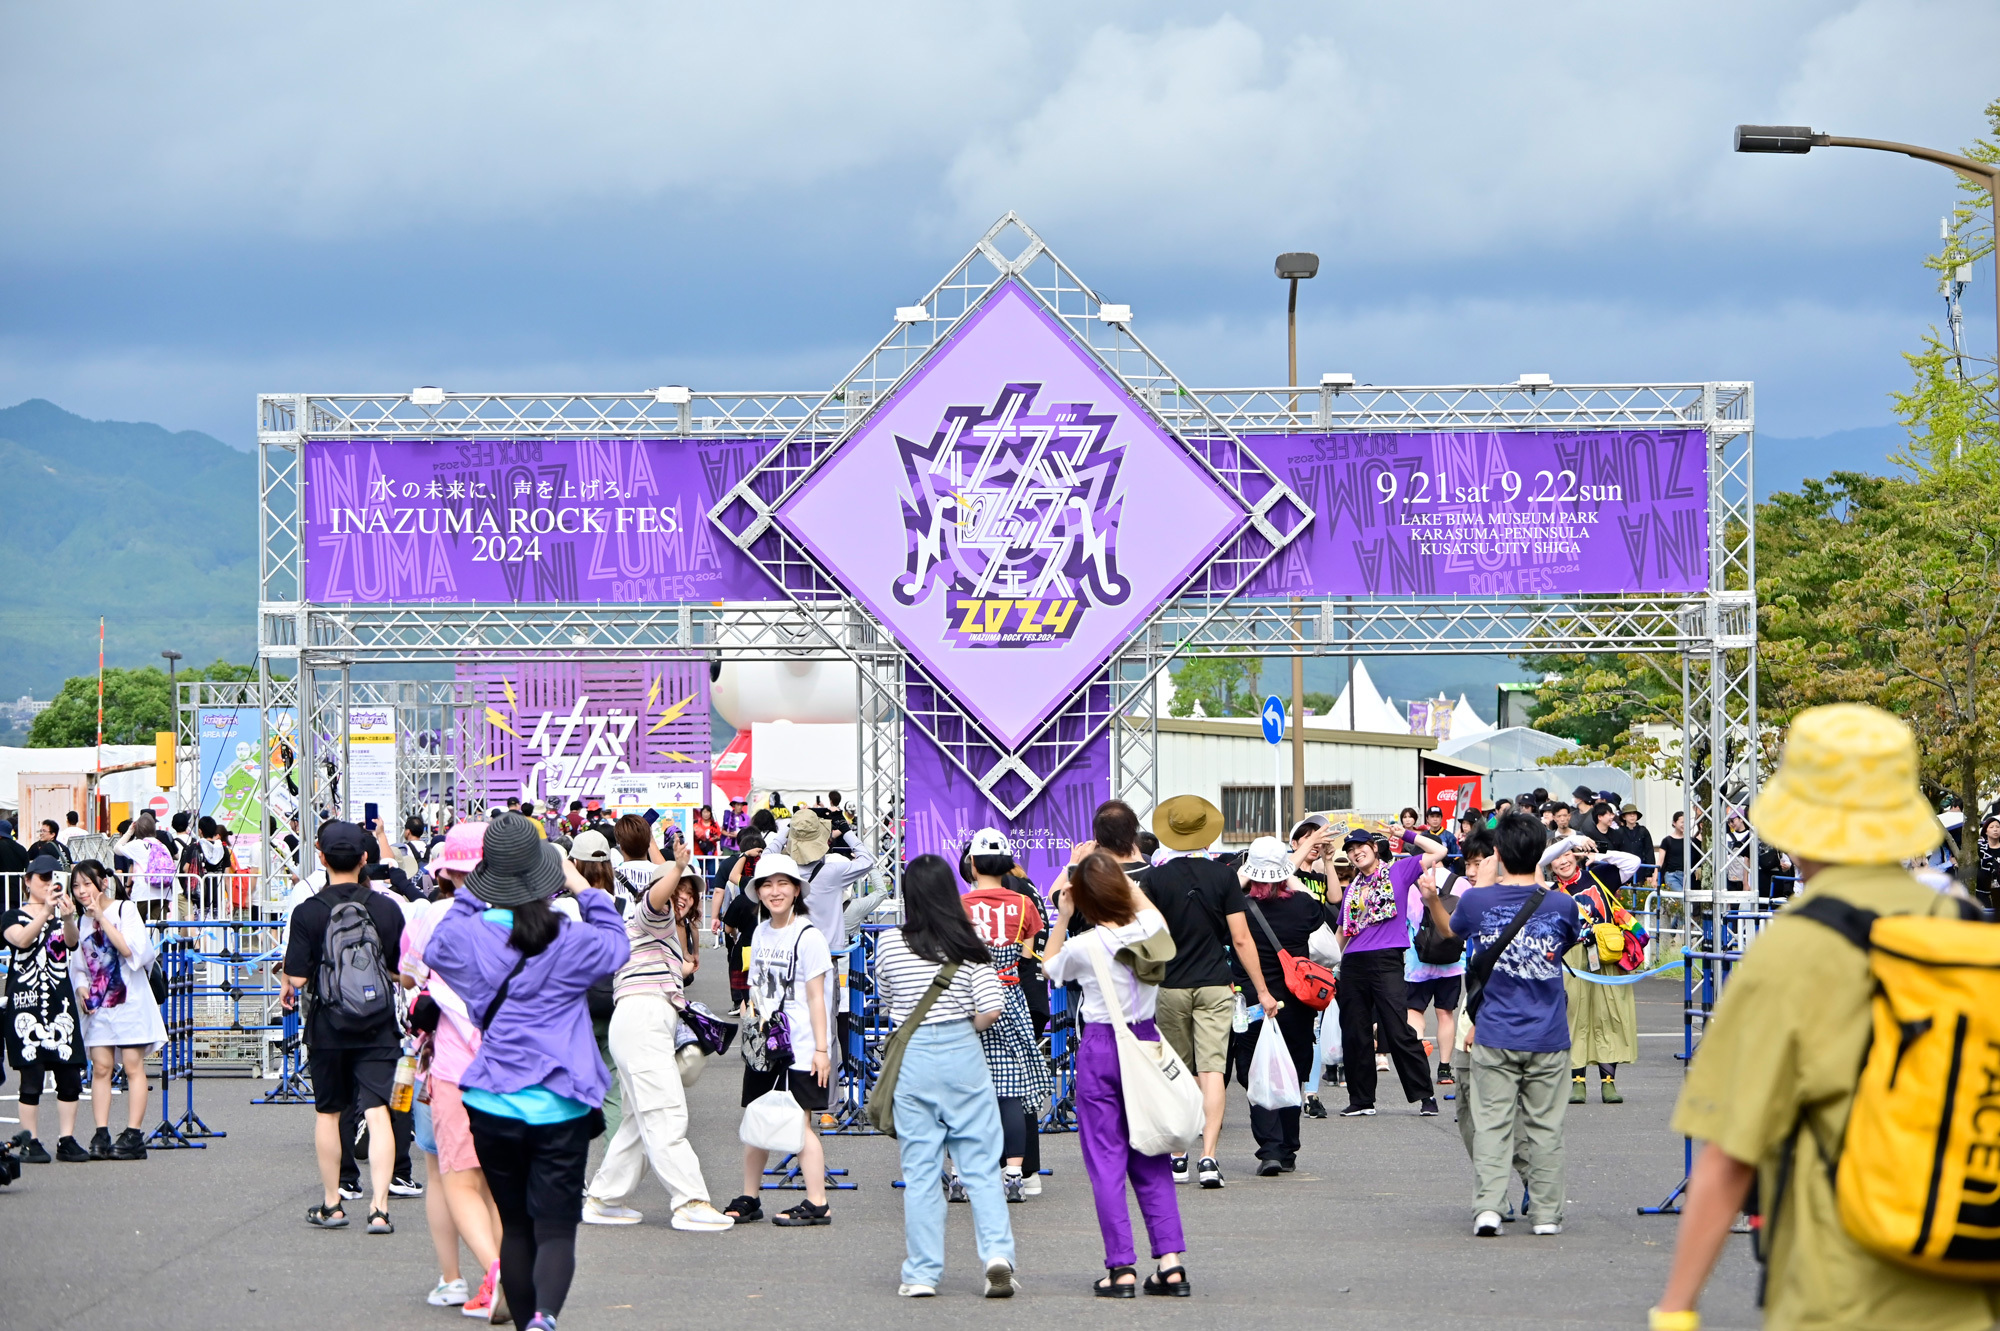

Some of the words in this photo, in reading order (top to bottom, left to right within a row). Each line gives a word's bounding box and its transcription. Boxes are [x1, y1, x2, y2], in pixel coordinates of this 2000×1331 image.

[370, 474, 631, 502] 水の未来に、声を上げろ。
[1376, 471, 1490, 505] 9.21sat
[1500, 469, 1624, 504] 9.22sun
[330, 507, 501, 534] INAZUMA
[507, 507, 606, 534] ROCK
[614, 506, 684, 533] FES.
[1400, 513, 1442, 526] LAKE
[1445, 513, 1486, 526] BIWA
[1487, 512, 1555, 526] MUSEUM
[1558, 511, 1599, 525] PARK
[1410, 526, 1590, 541] KARASUMA-PENINSULA
[471, 535, 543, 562] 2024
[1420, 541, 1531, 556] KUSATSU-CITY
[1533, 540, 1582, 554] SHIGA
[956, 600, 1079, 633] 2024
[968, 633, 1001, 642] INAZUMA
[1001, 633, 1022, 642] ROCK
[202, 730, 222, 738] AREA
[222, 730, 238, 738] MAP
[1009, 838, 1045, 850] ROCK
